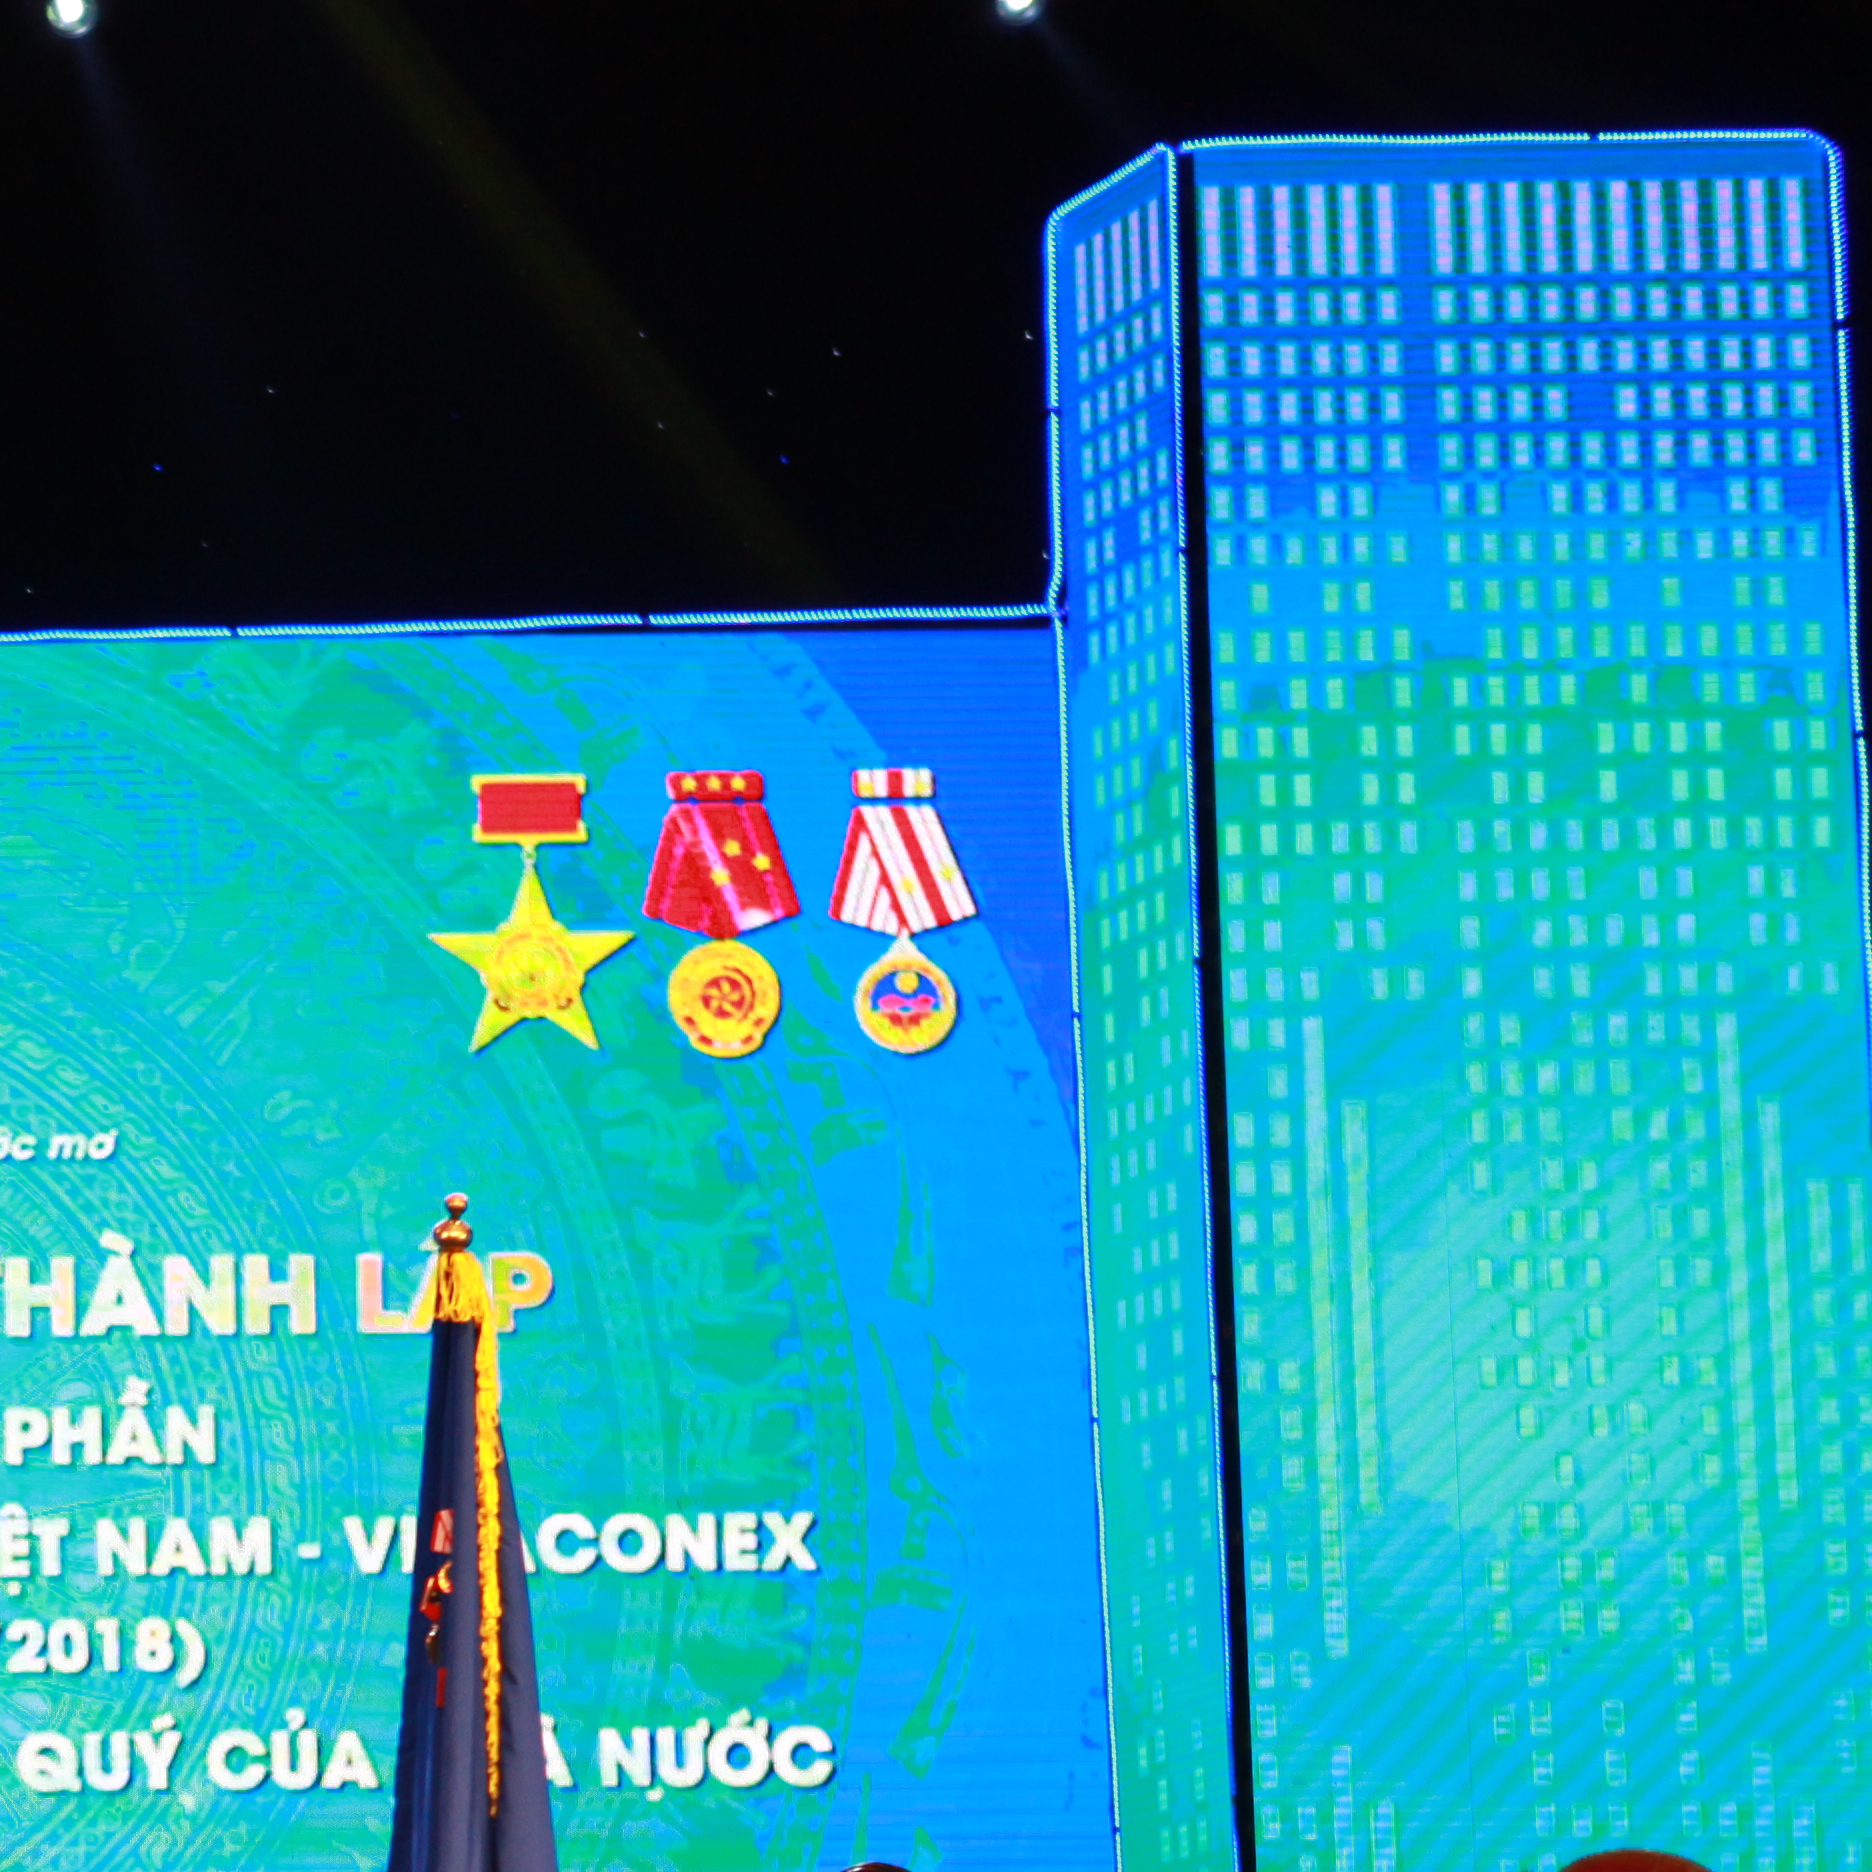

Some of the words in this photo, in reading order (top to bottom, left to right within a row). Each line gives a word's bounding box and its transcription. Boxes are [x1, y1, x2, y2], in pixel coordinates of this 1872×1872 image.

[48, 1131, 117, 1159] mơ
[4, 1377, 214, 1464] PHẦN
[97, 1516, 271, 1575] NAM
[343, 1511, 818, 1574] VICONEX
[17, 1713, 180, 1791] QUÝ
[208, 1710, 377, 1788] CỦA
[600, 1710, 831, 1800] NƯỚC
